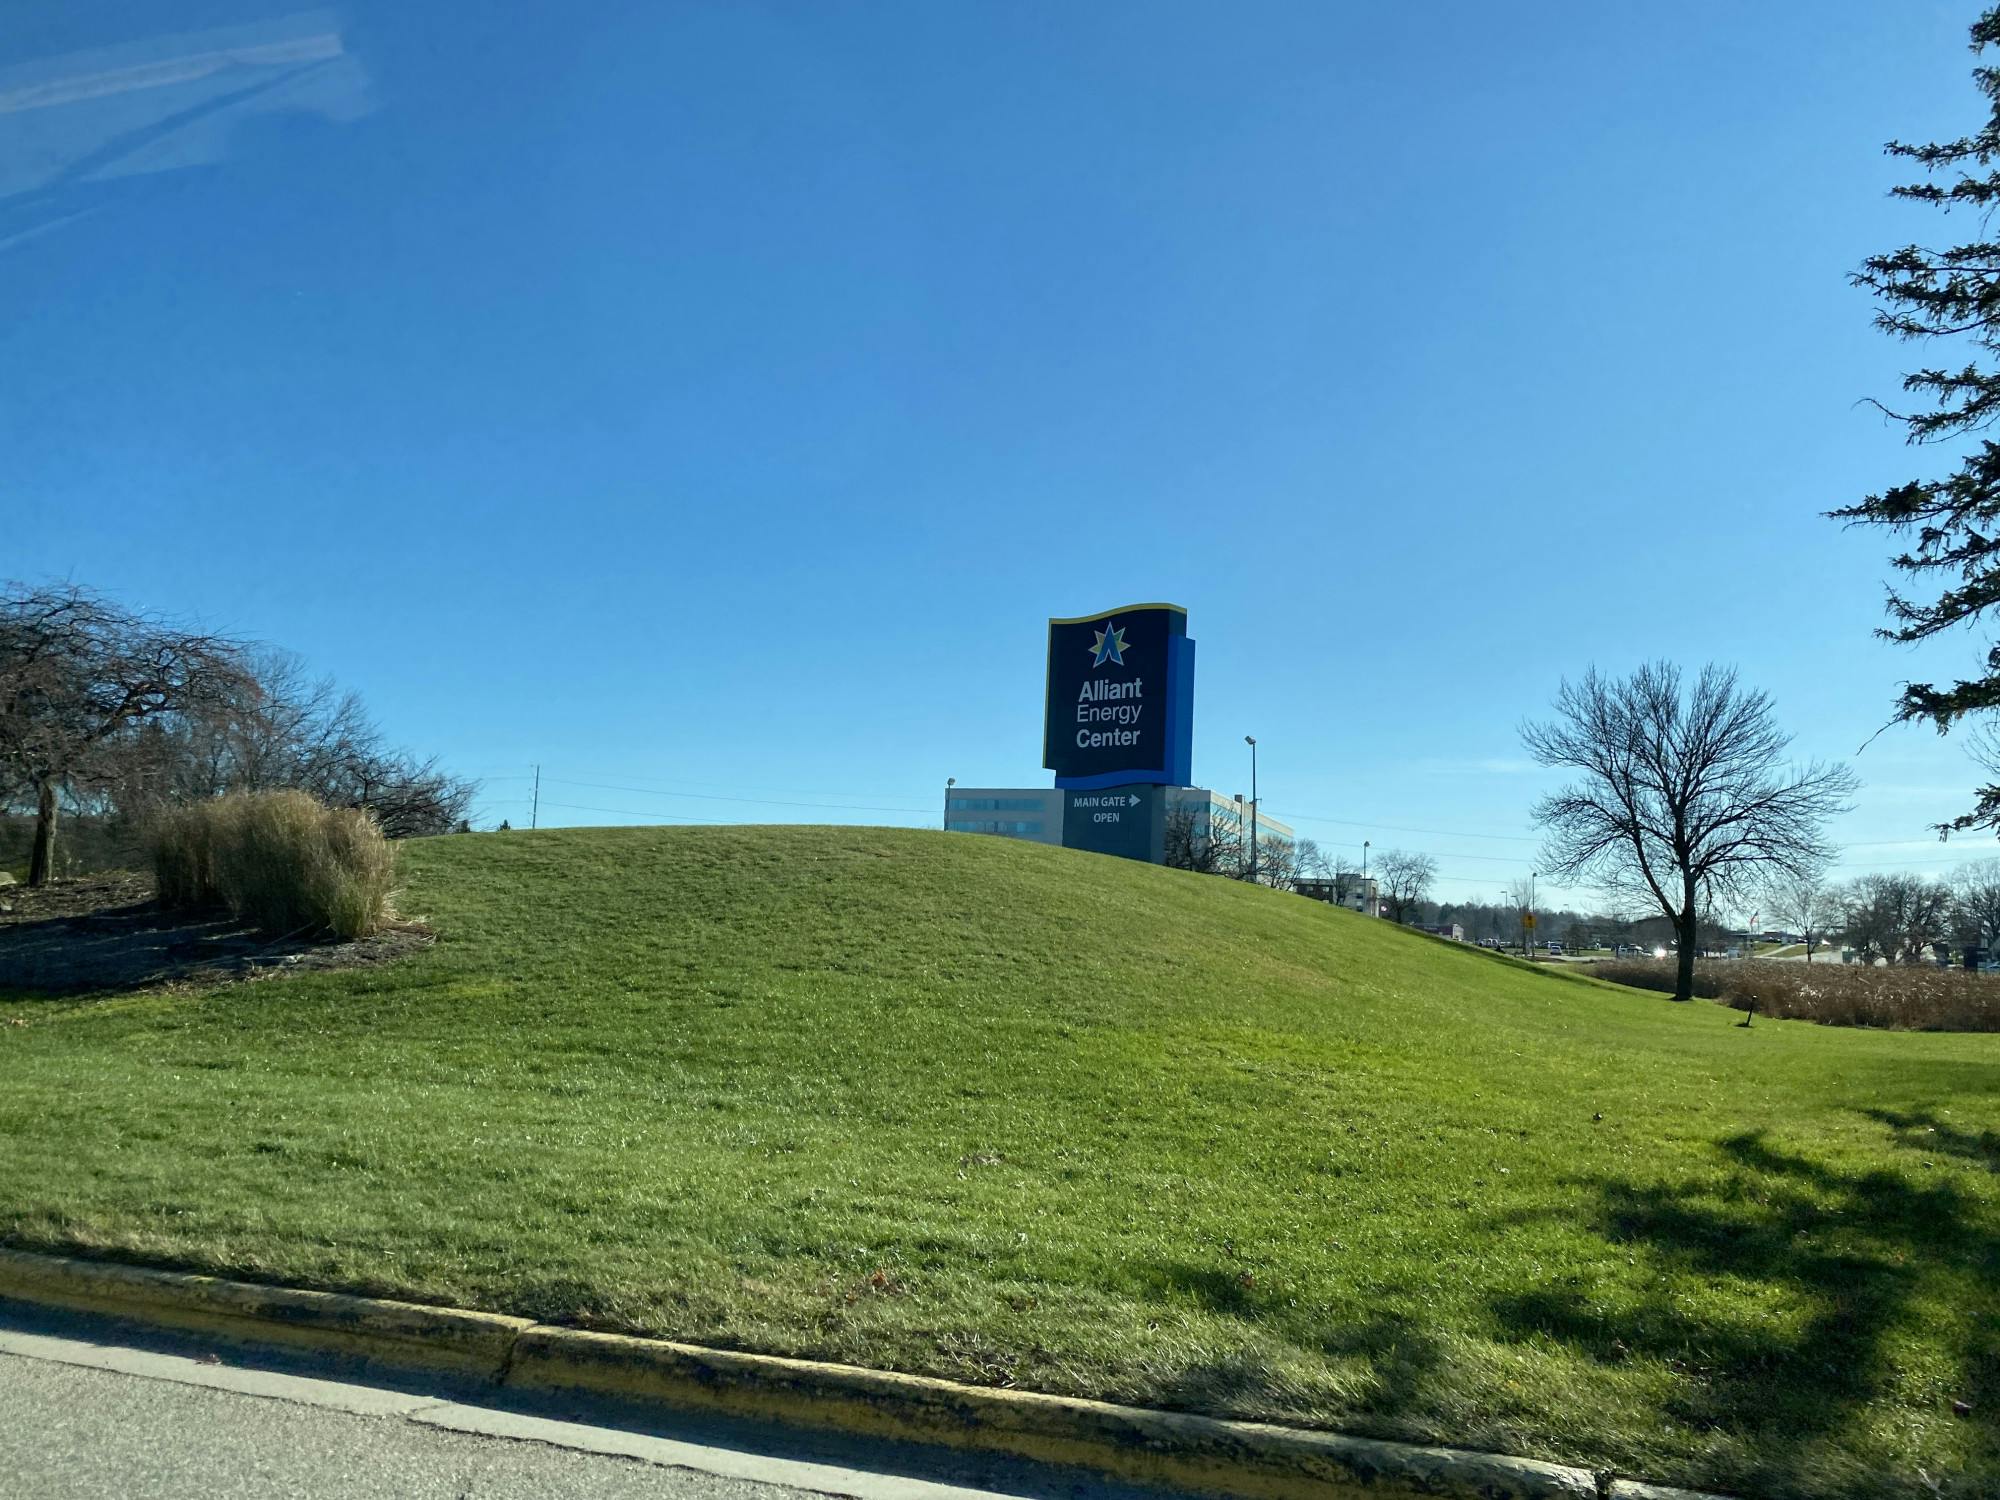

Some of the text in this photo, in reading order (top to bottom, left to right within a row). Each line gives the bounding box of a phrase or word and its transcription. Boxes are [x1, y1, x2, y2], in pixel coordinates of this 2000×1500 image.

[1078, 678, 1143, 702] Alliant
[1077, 704, 1142, 725] Energy
[1076, 728, 1141, 748] Center
[1074, 796, 1126, 808] MAIN GATE
[1093, 812, 1120, 823] OPEN
